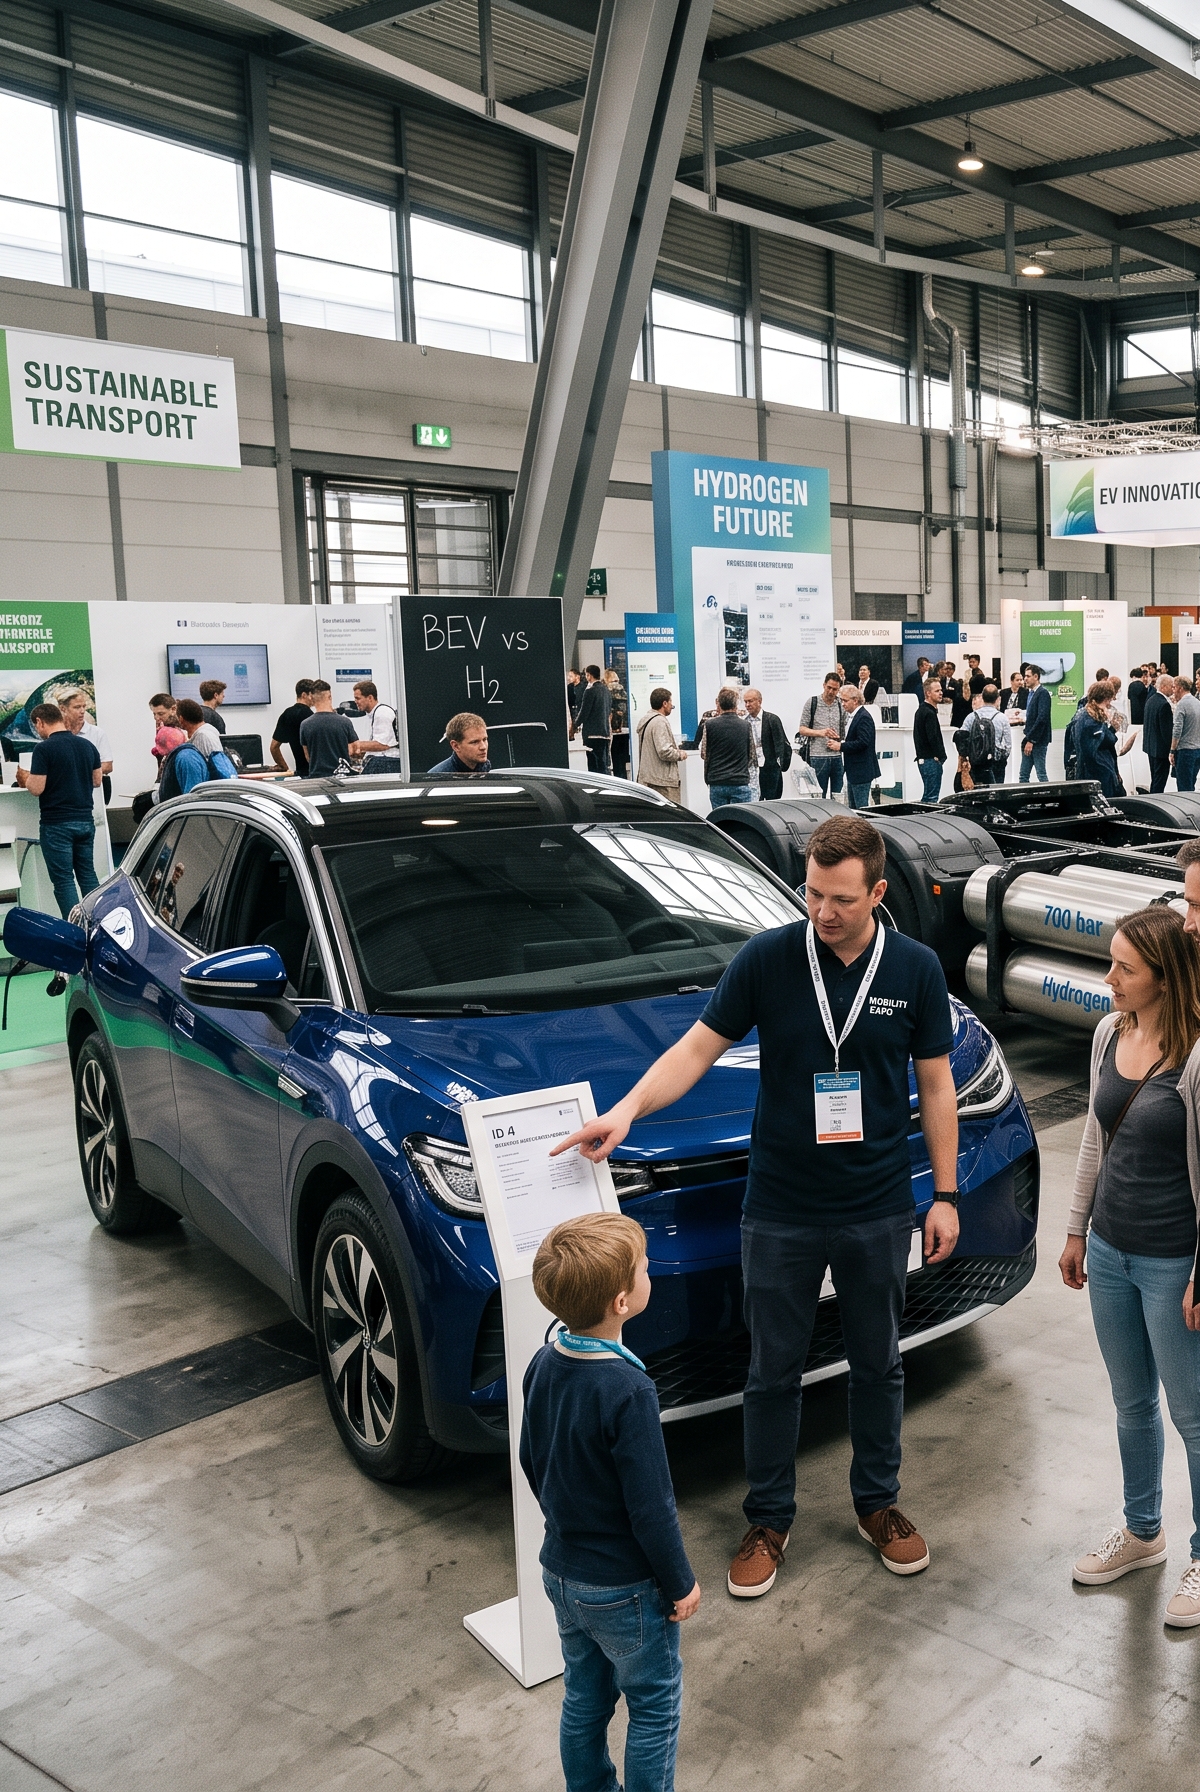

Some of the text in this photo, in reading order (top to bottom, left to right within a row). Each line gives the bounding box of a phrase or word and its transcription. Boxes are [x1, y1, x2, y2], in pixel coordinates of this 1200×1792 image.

[24, 360, 218, 409] SUSTAINABLE
[25, 397, 198, 440] TRANSPORT
[693, 468, 808, 506] HYDROGEN
[1100, 487, 1118, 505] EV
[713, 505, 794, 538] FUTURE
[422, 614, 529, 651] BEV vs
[466, 665, 504, 704] H2
[1044, 904, 1103, 937] 700 bar
[869, 996, 908, 1009] MOBILITY
[1042, 975, 1111, 1013] Hydrogen
[491, 1128, 504, 1140] ID
[507, 1125, 516, 1136] 4
